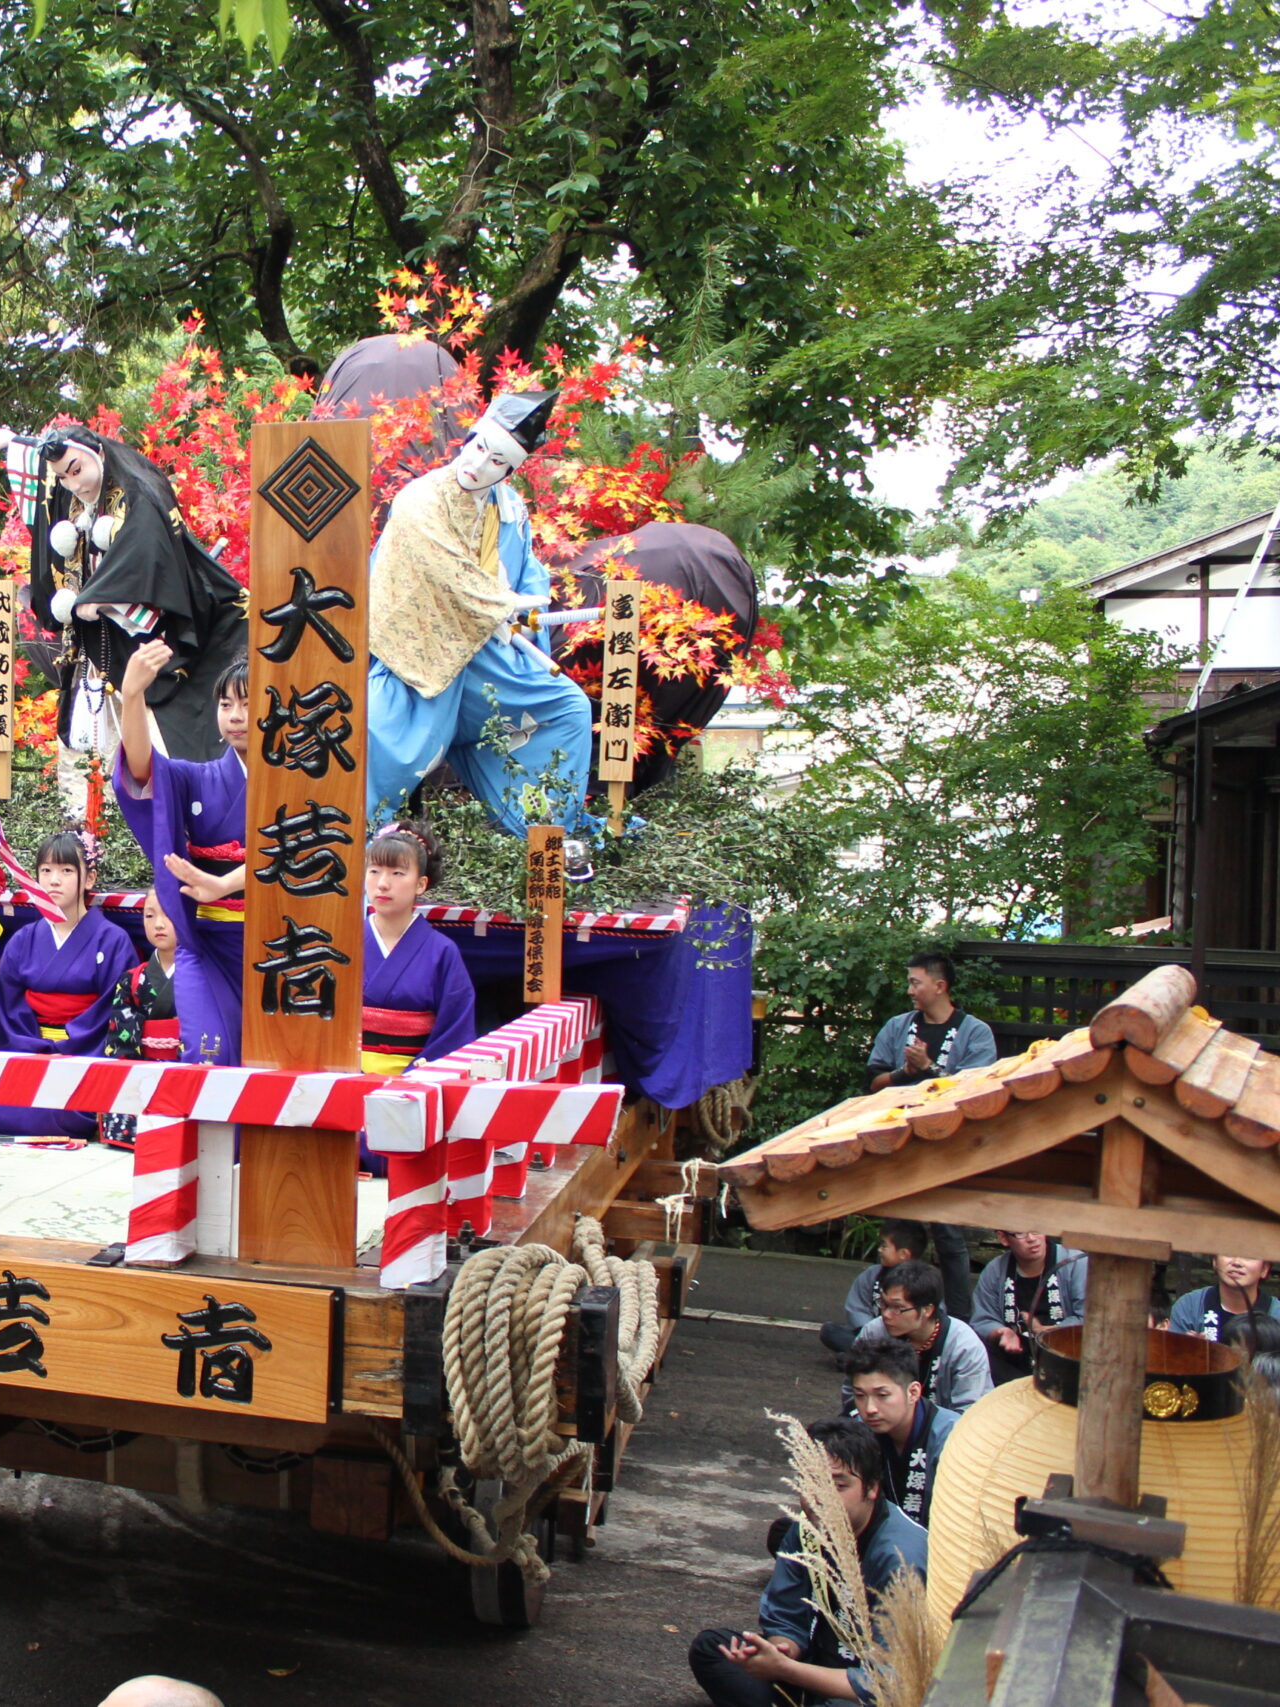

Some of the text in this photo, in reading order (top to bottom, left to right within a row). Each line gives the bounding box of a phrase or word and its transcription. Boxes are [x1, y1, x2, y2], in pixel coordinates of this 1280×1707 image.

[253, 566, 357, 1021] 大塚若者
[902, 1447, 928, 1521] 大塚若
